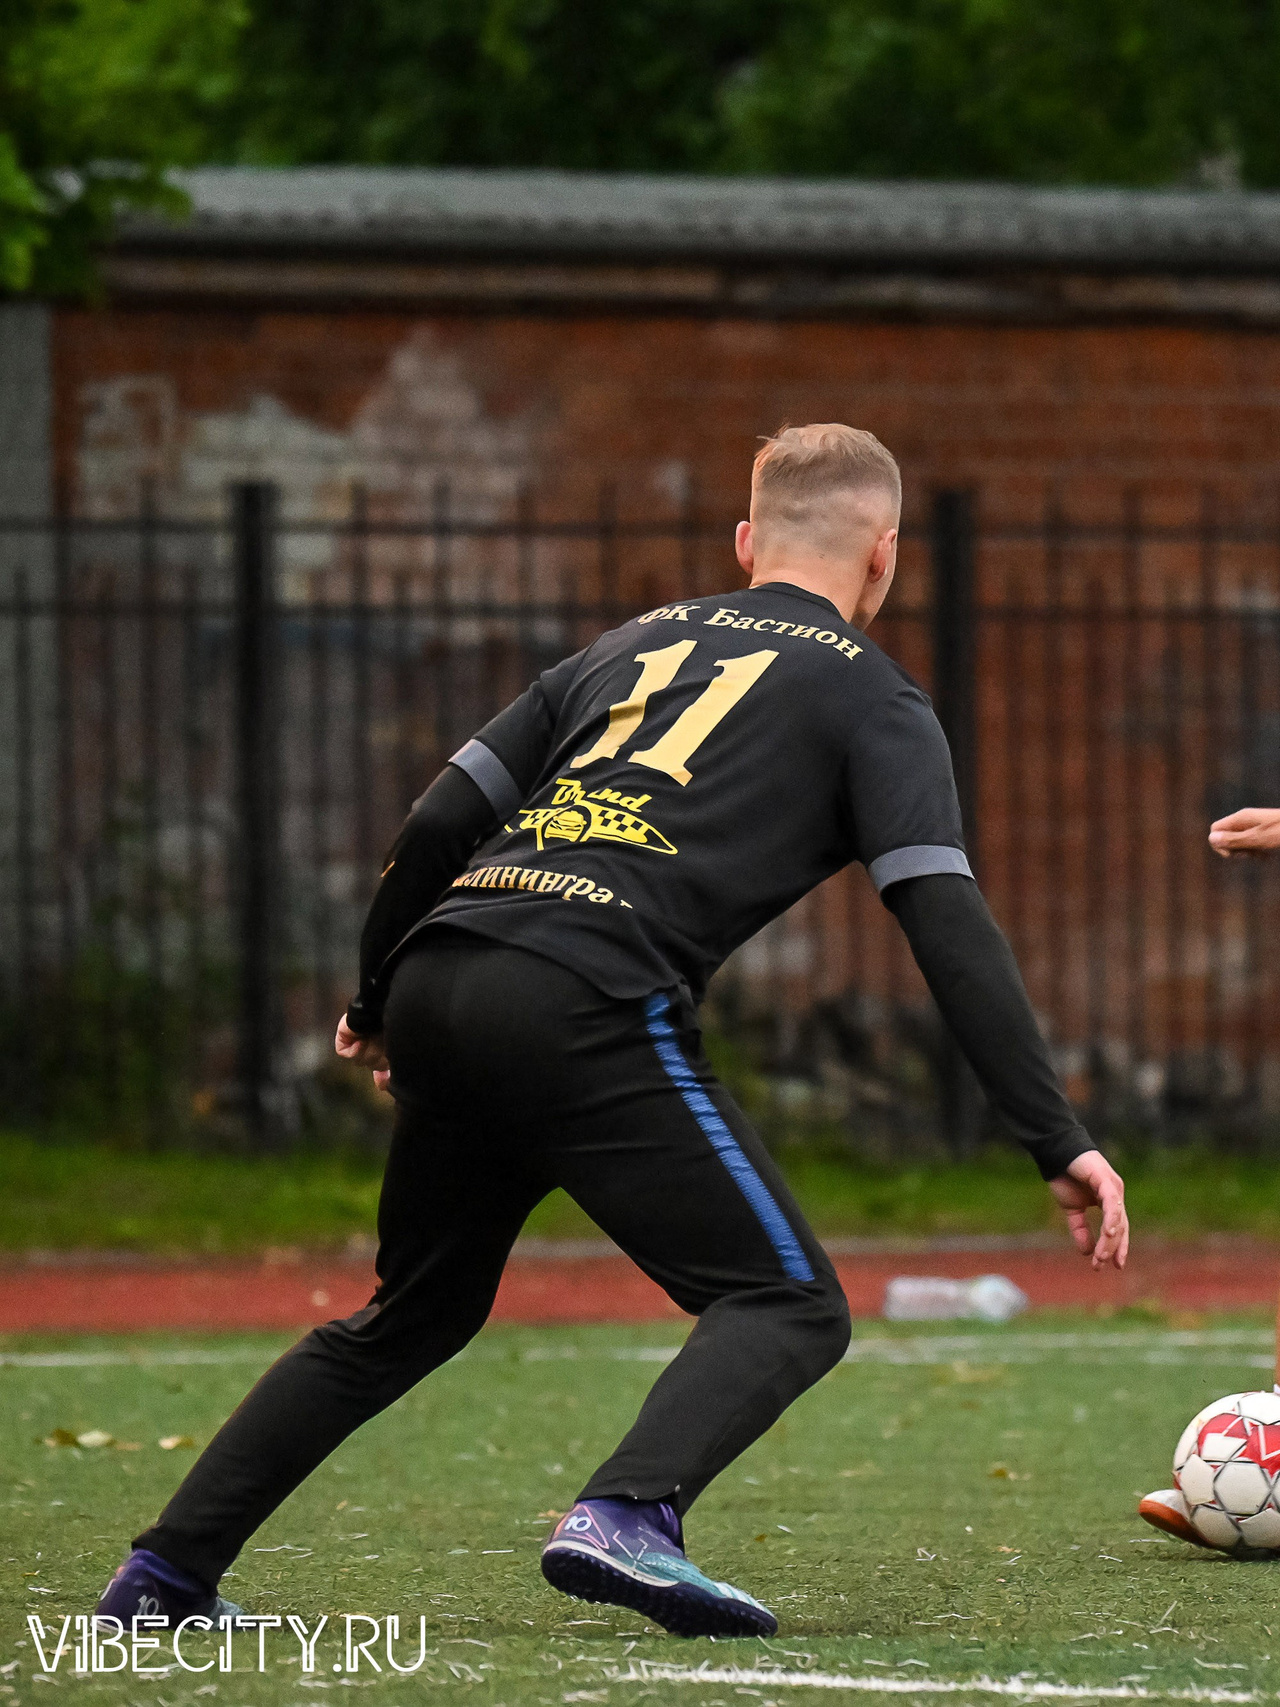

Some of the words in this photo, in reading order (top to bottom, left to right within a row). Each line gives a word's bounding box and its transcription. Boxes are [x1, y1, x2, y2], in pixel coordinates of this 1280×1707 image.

[703, 607, 863, 661] Бастион
[569, 639, 780, 787] 11
[564, 1515, 592, 1531] 10
